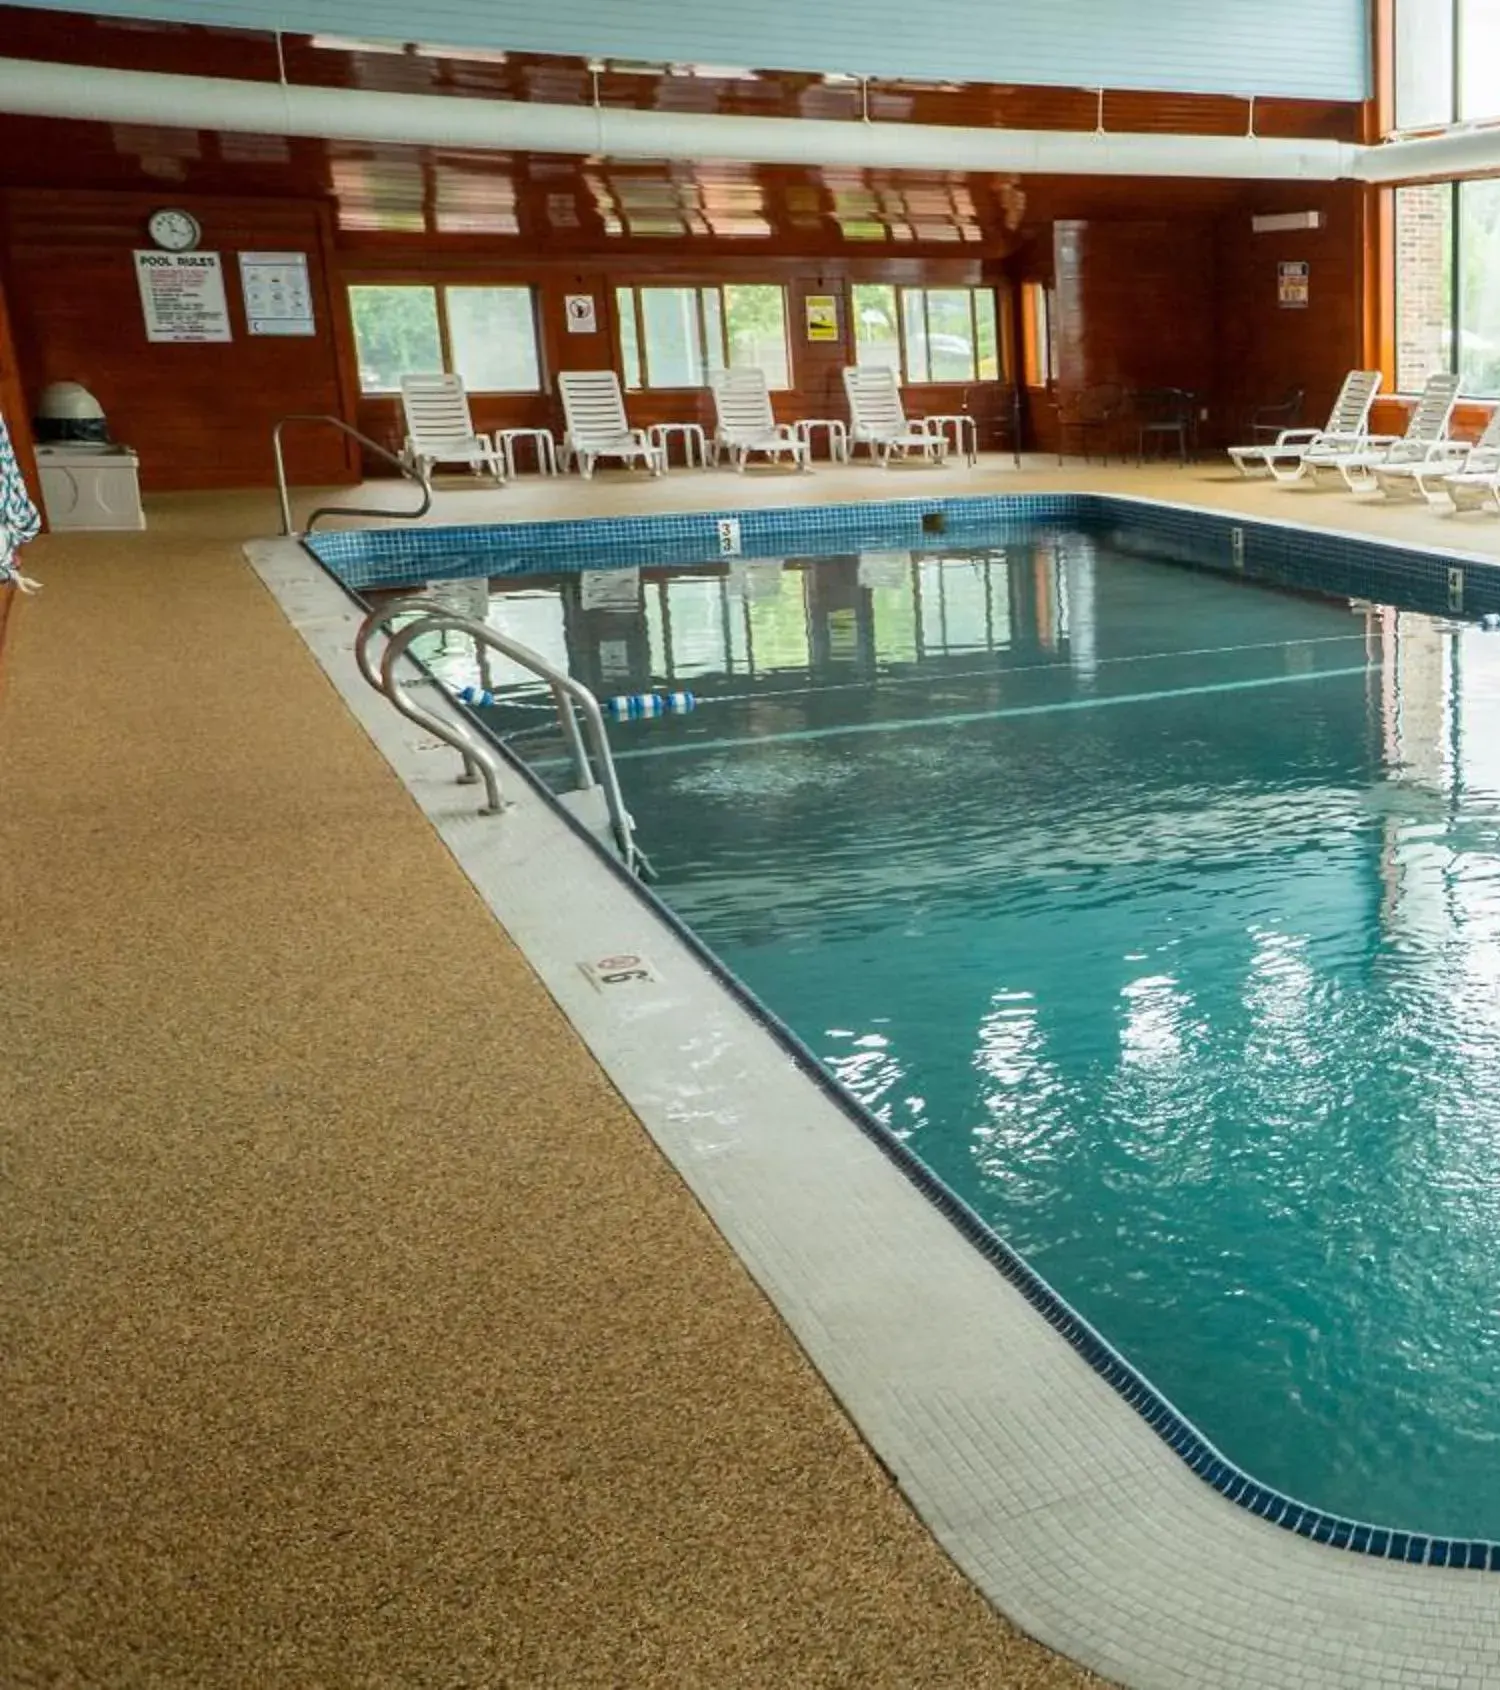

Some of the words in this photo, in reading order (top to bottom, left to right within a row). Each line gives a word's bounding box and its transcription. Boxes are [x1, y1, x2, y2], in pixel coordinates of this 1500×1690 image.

[140, 255, 172, 267] POOL
[177, 256, 215, 267] RULES
[721, 522, 731, 536] 3
